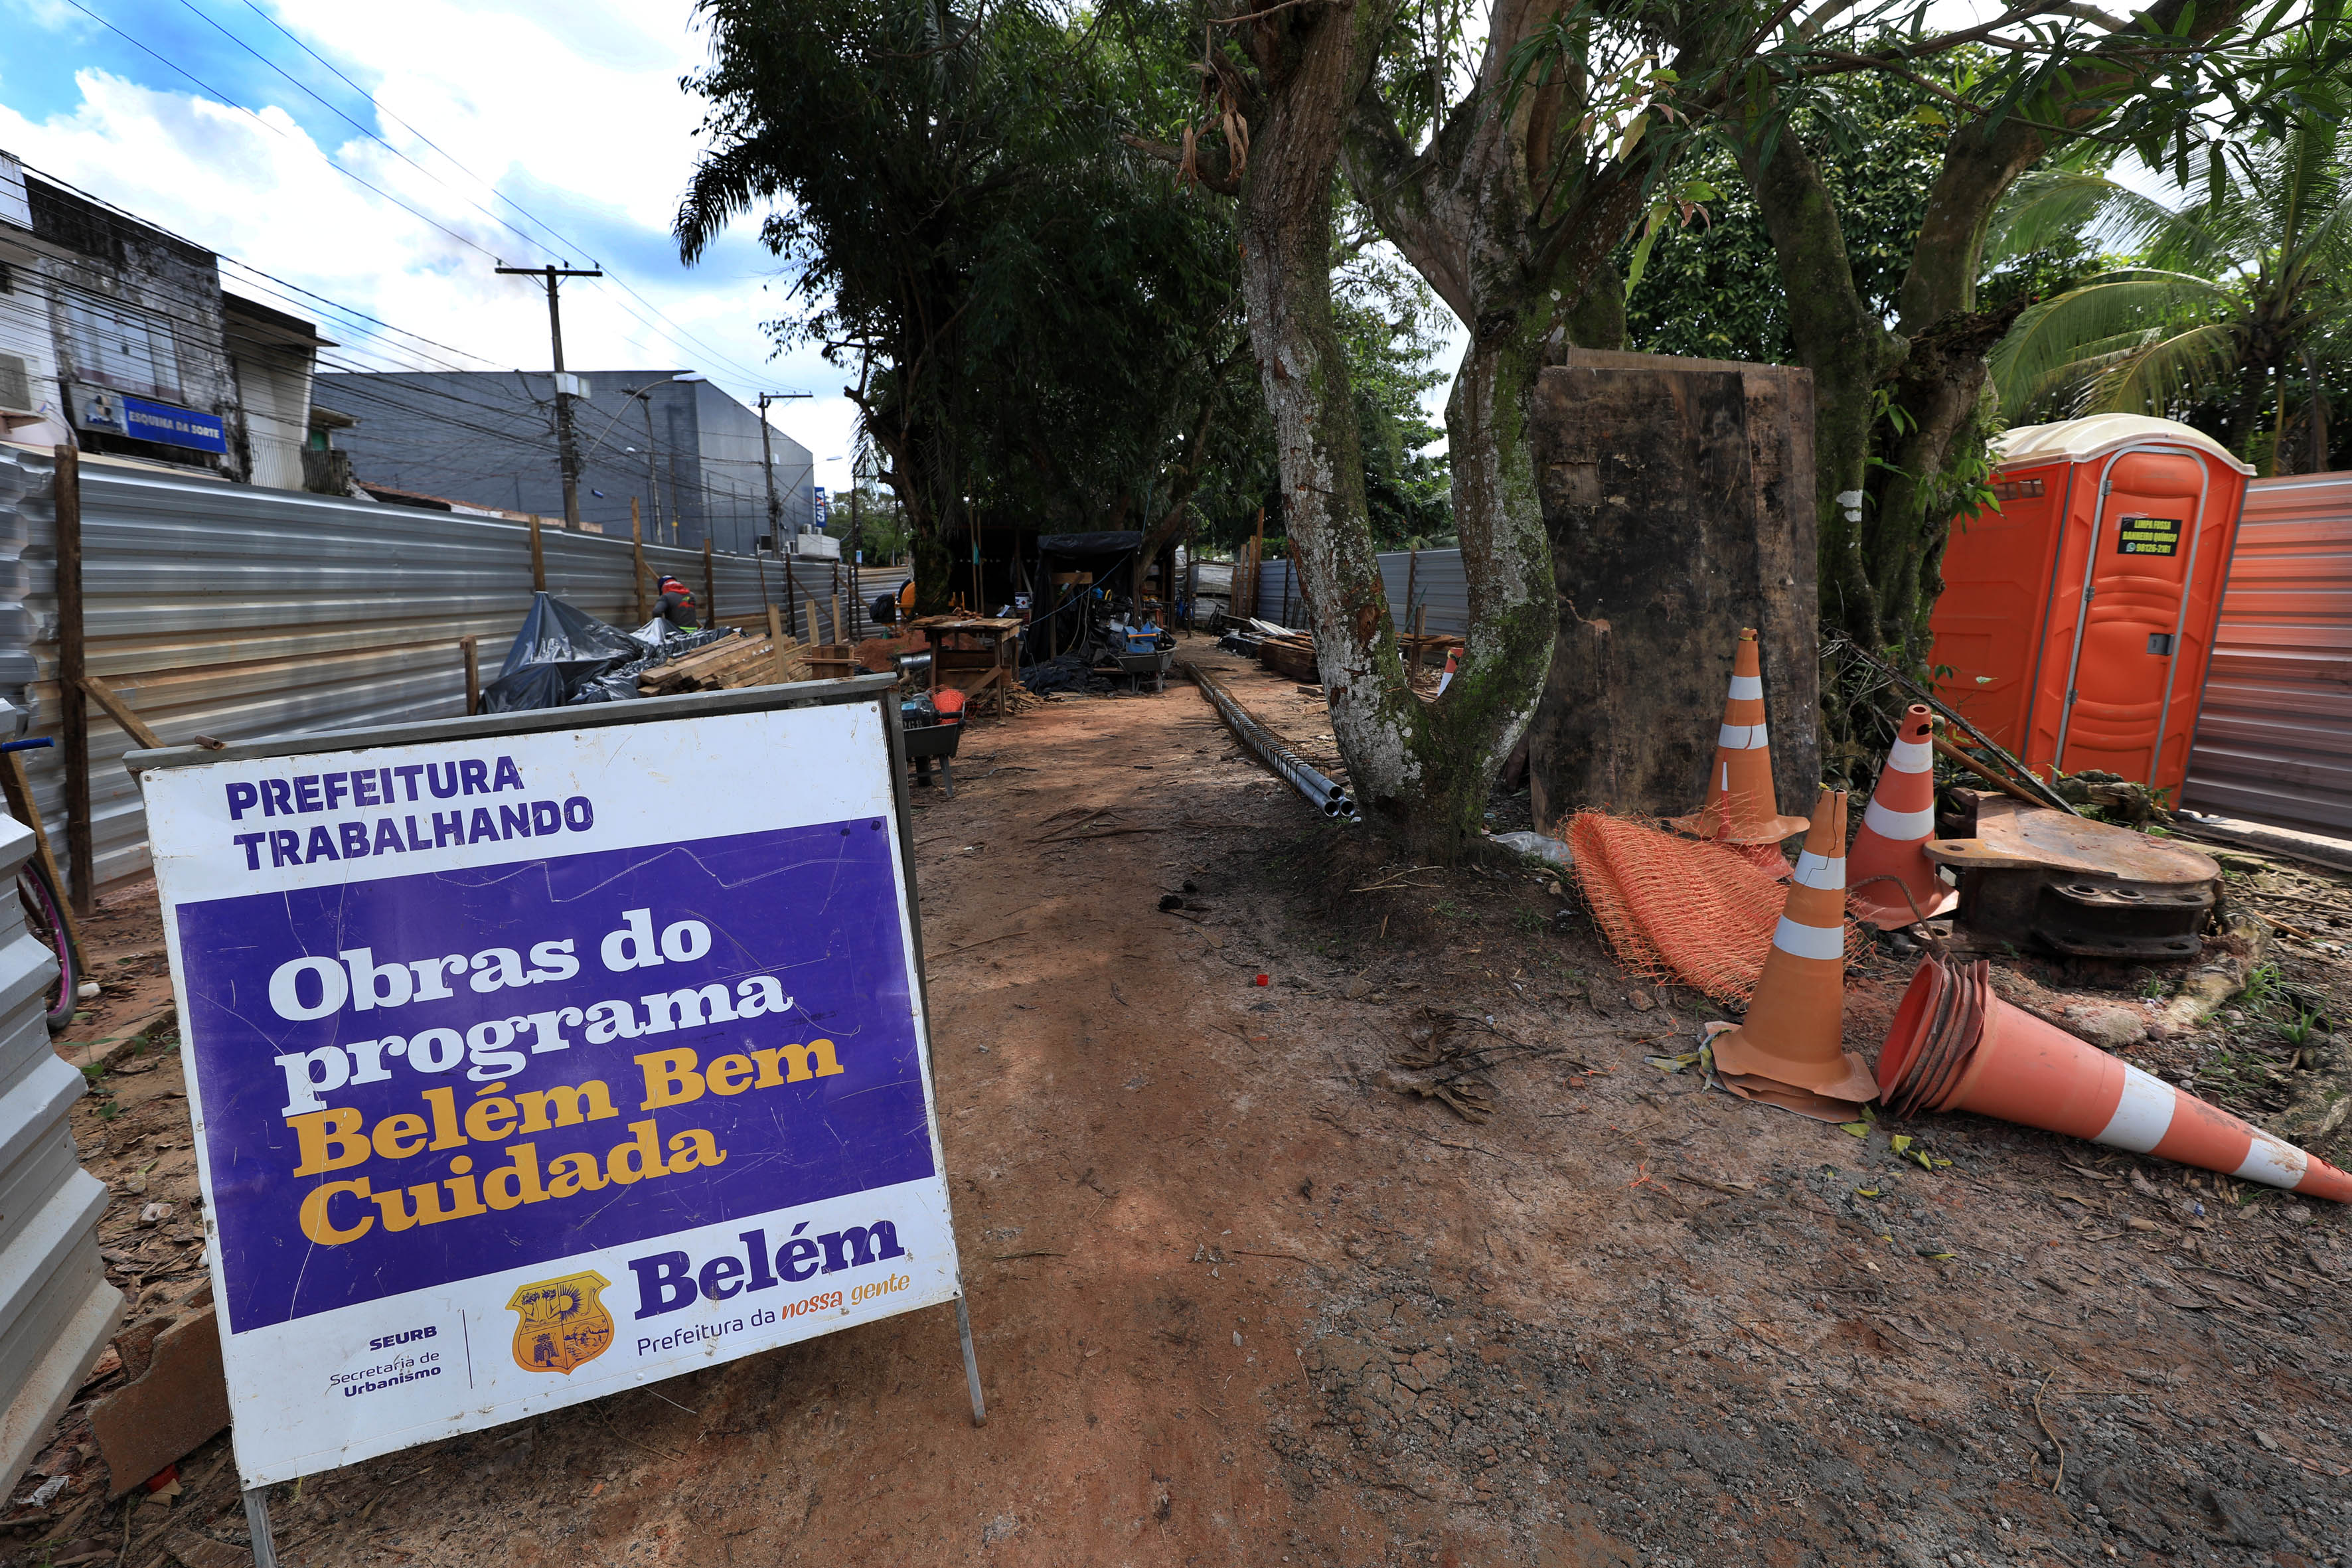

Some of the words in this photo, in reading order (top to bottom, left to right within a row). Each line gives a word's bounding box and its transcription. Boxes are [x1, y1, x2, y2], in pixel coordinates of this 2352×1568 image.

[129, 410, 175, 431] ESQUINA
[176, 420, 190, 433] DA
[191, 424, 220, 439] SORTE
[816, 491, 824, 522] CAIXA
[225, 755, 525, 821] PREFEITURA
[233, 796, 594, 871] TRABALHANDO
[268, 938, 580, 1021] Obras
[600, 907, 712, 973] do
[275, 975, 794, 1118] programa
[285, 1081, 619, 1178] Belém
[633, 1038, 844, 1111] Bem
[299, 1119, 727, 1246] Cuidada
[628, 1219, 905, 1320] Belém
[369, 1326, 438, 1352] SEURB
[637, 1318, 744, 1356] Prefeitura
[751, 1308, 776, 1328] da
[781, 1291, 843, 1320] nossa
[850, 1273, 910, 1306] gente
[329, 1358, 416, 1387] Secretaria
[420, 1352, 440, 1364] de
[344, 1366, 441, 1397] Urbanismo
